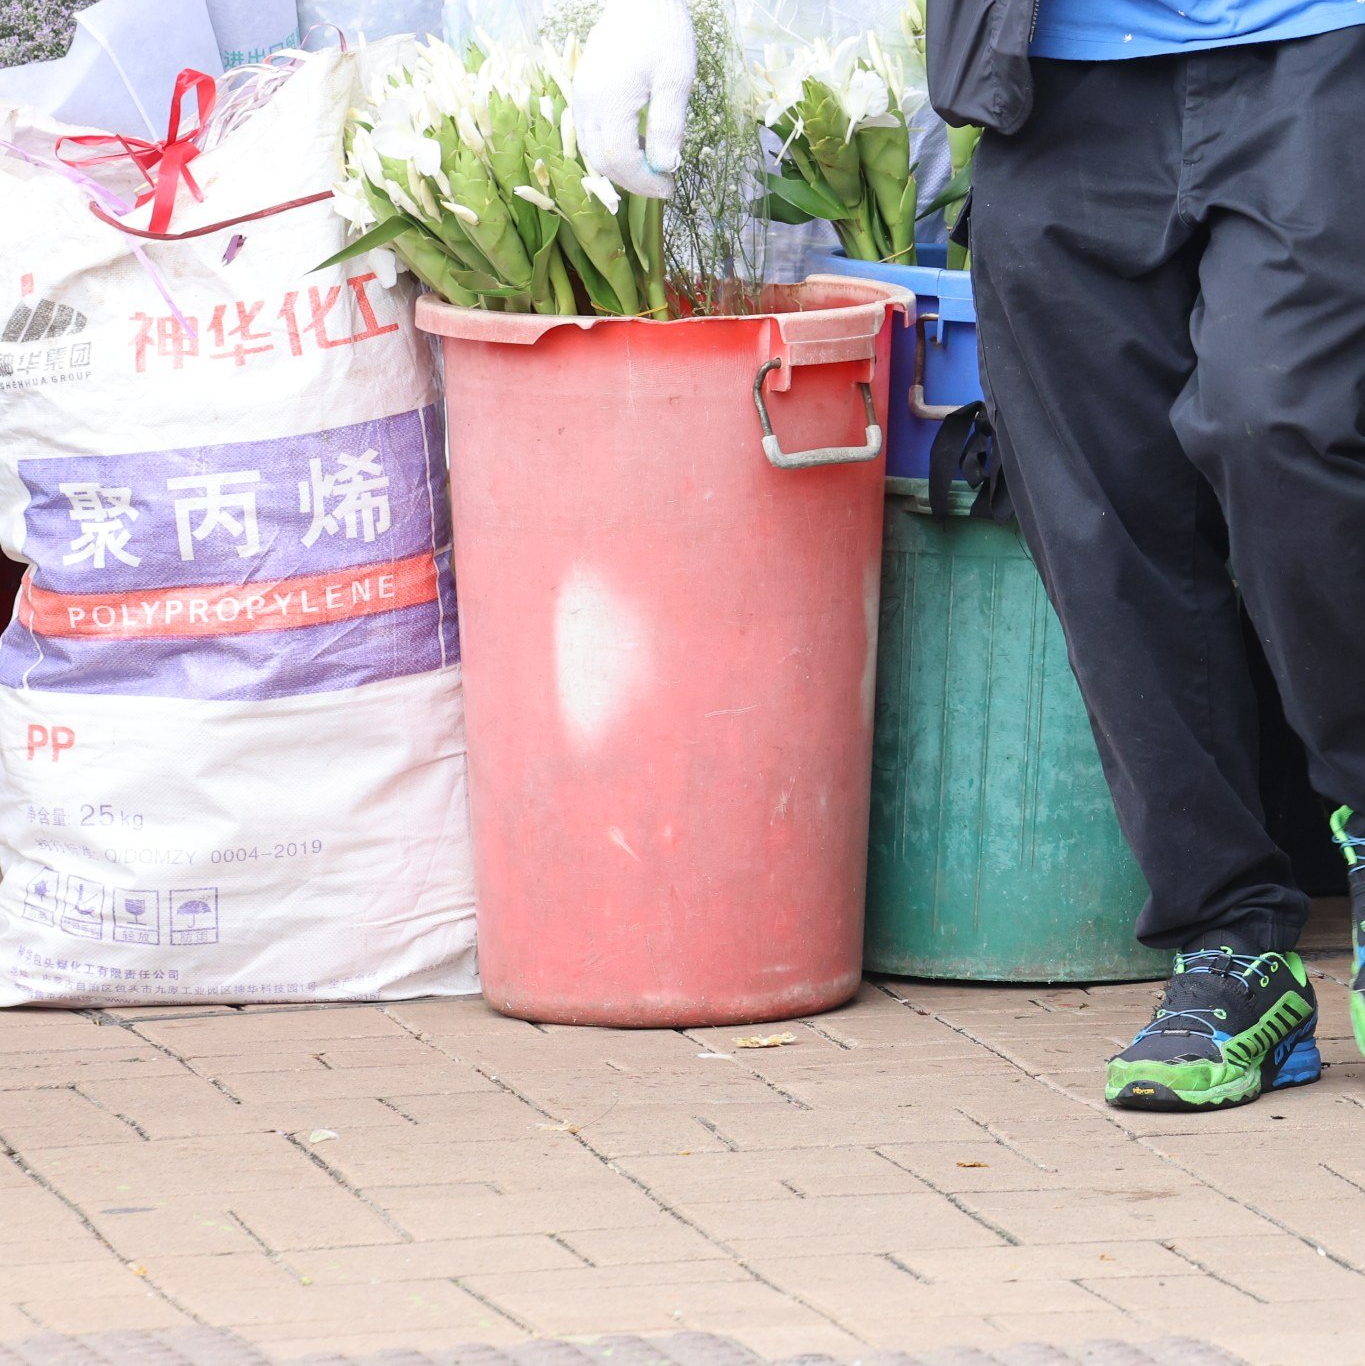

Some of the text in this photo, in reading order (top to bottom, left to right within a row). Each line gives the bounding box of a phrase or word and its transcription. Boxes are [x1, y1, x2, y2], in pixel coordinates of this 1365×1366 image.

[128, 271, 400, 374] 神华化工
[51, 370, 92, 384] GROUP
[60, 448, 392, 570] 聚丙烯
[68, 574, 396, 630] POLYPROPYLENE
[27, 723, 76, 763] PP
[79, 804, 115, 827] 25
[119, 809, 145, 831] kg
[210, 839, 323, 865] 0004-2019
